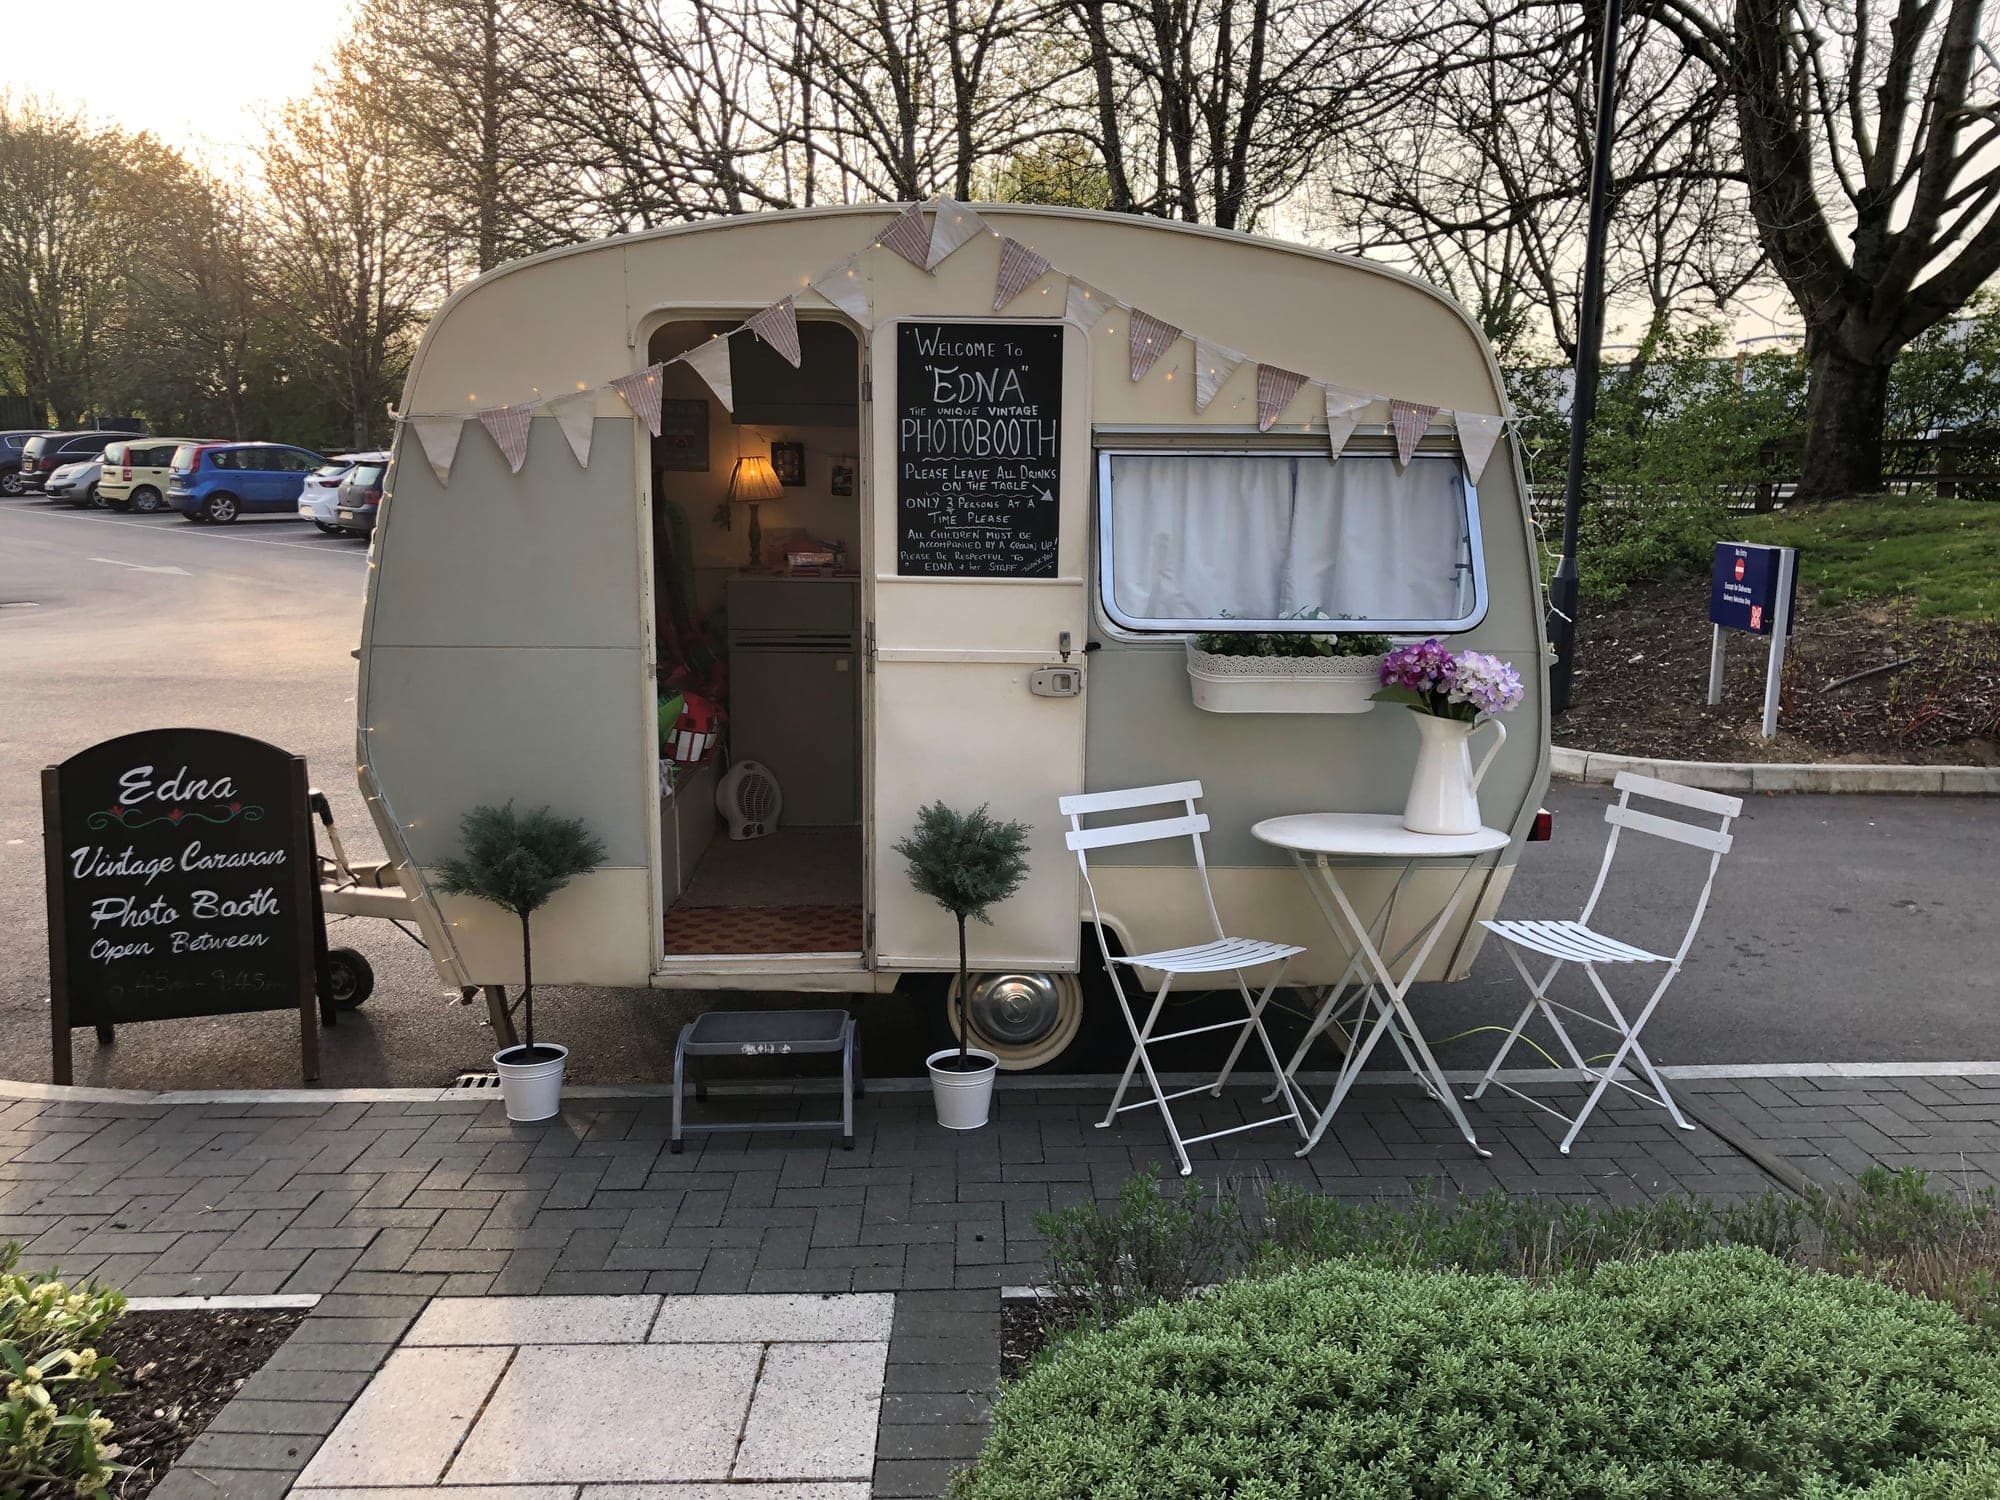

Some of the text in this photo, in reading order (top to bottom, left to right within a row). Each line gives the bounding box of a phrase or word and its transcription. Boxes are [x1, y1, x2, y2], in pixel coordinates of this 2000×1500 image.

[910, 405, 1039, 416] THE UNIQUE VINTAGE
[902, 418, 1057, 458] PHOTOBOOTH
[905, 463, 1057, 479] PLEASE LEAVE ALL DRINKS
[942, 481, 1030, 492] ON THE TABLE
[906, 498, 940, 508] ONLY
[946, 497, 953, 509] 3
[958, 497, 1000, 509] PERSONS
[1028, 499, 1035, 508] A
[928, 511, 1011, 525] TIME PLEASE
[930, 530, 980, 540] CHILDREN
[986, 532, 1012, 540] MUST
[1019, 532, 1032, 540] BE
[919, 541, 982, 550] ACCOMPANIED
[985, 541, 996, 550] BY
[1000, 541, 1005, 550] A
[1010, 542, 1037, 551] GROWN
[925, 562, 954, 571] EDNA
[989, 562, 1018, 571] STAFF
[119, 765, 238, 805] Edna
[70, 840, 287, 886] Vintage Caravan
[90, 887, 281, 930] Photo Booth
[90, 931, 270, 965] Open Between
